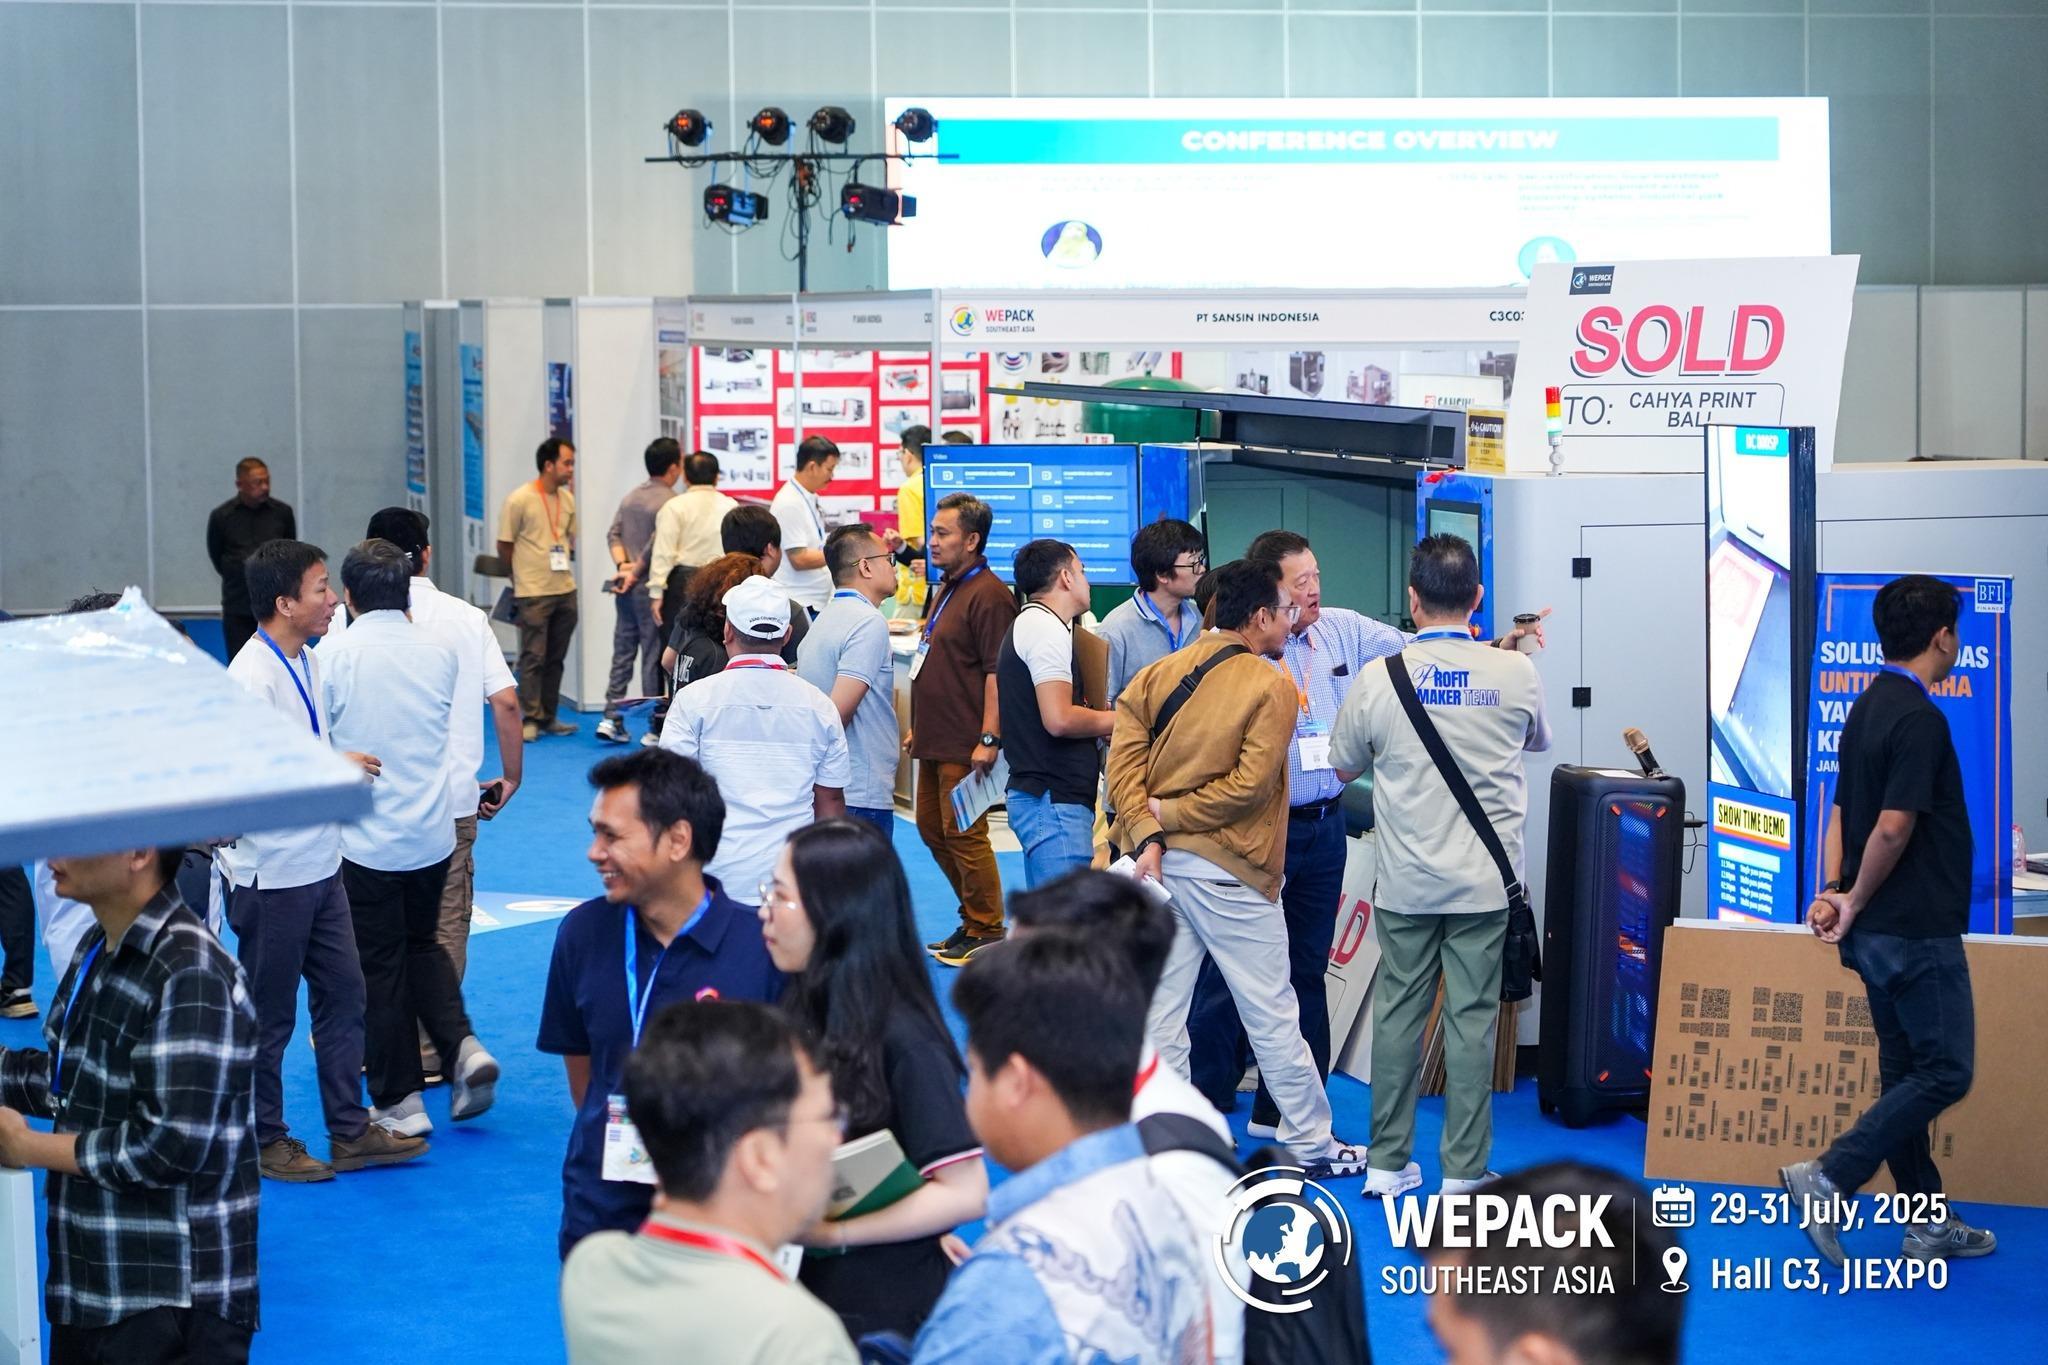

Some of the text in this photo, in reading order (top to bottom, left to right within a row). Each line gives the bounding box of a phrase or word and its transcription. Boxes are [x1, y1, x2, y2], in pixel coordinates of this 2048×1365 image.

[1181, 130, 1559, 151] CONFERENCE OVERVIEW
[985, 309, 1035, 321] WEPACK
[1196, 313, 1320, 322] PT SANSIN INDONESIA
[1570, 304, 1786, 377] SOLD
[1563, 391, 1757, 425] TO: CAHYA PRINT
[1480, 423, 1502, 433] CAUTION
[1979, 584, 2002, 601] BFI
[1412, 663, 1470, 689] PROFIT
[1416, 688, 1500, 706] MAKER TEAM
[1718, 803, 1785, 838] SHOW TIME DEMO
